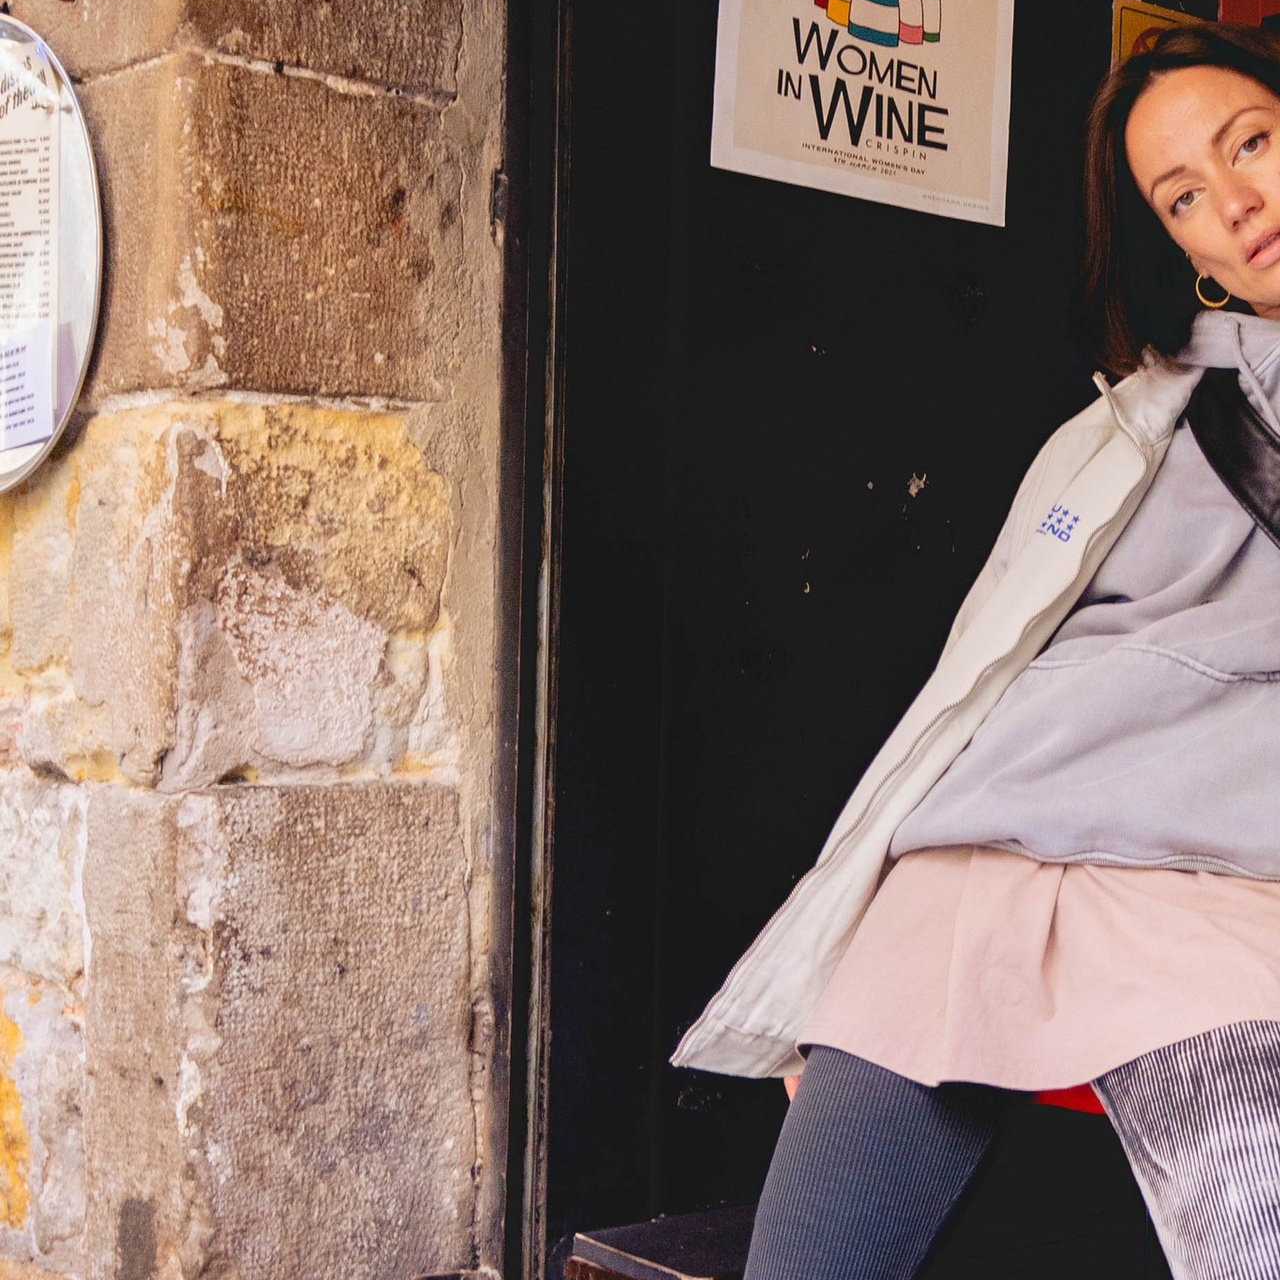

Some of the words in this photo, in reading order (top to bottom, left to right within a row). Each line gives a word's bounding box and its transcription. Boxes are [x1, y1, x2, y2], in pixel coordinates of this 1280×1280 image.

[792, 17, 938, 100] WOMEN
[777, 68, 802, 100] IN
[808, 73, 949, 151] WINE
[801, 142, 867, 162] INTERNATIONAL
[910, 166, 926, 176] DAY
[849, 161, 877, 172] MARCH
[865, 138, 927, 161] CRISPIN
